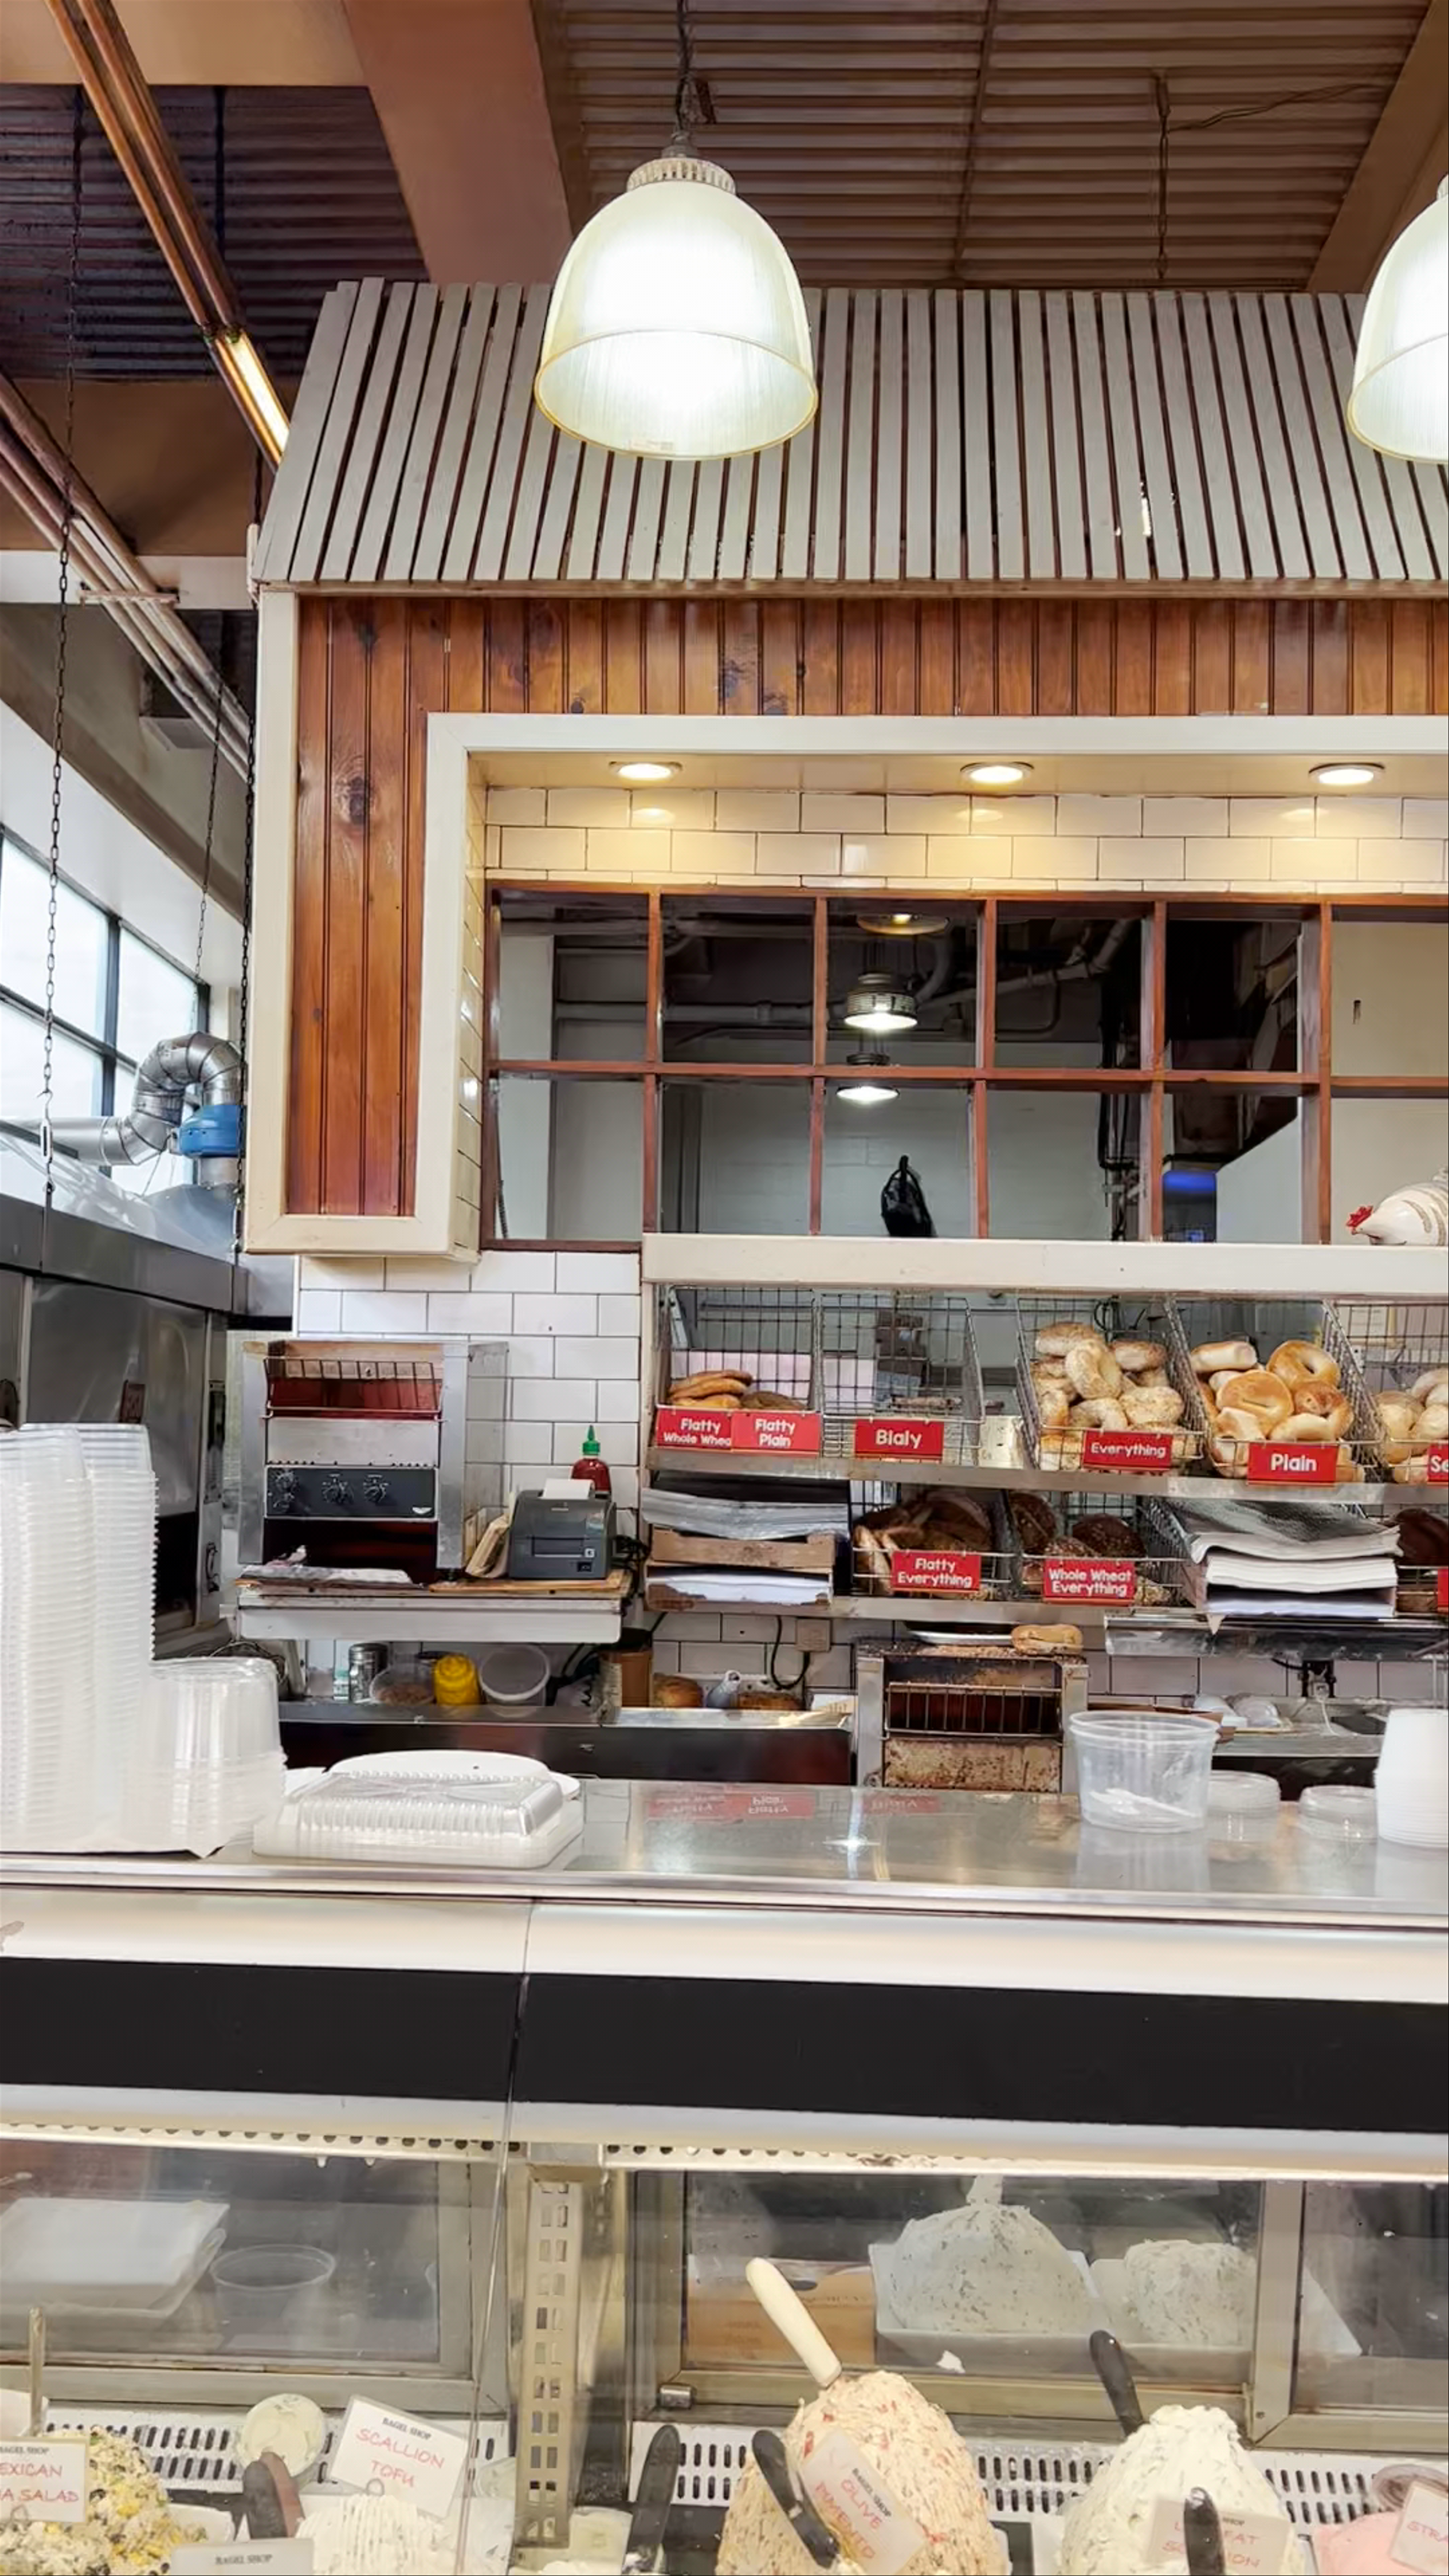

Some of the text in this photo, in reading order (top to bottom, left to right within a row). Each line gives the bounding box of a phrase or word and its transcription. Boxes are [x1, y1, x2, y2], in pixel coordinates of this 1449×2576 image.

[681, 1418, 720, 1433] Flatty
[755, 1419, 795, 1433] Flatty
[663, 1433, 731, 1446] Whole Whea
[760, 1434, 791, 1447] Plain
[875, 1429, 922, 1449] Bialy
[1091, 1443, 1166, 1458] Everything
[1271, 1454, 1317, 1471] Plain
[915, 1558, 955, 1573] Flatty
[898, 1572, 973, 1589] Everything
[1049, 1568, 1132, 1581] Whole Wheat
[1052, 1581, 1127, 1598] Everything
[382, 2417, 432, 2440] BAGEL SHOP
[356, 2428, 445, 2469] SCALLION
[20, 2489, 79, 2502] SALAD
[841, 2479, 883, 2529] OLIVE
[246, 2554, 273, 2563] SHOP
